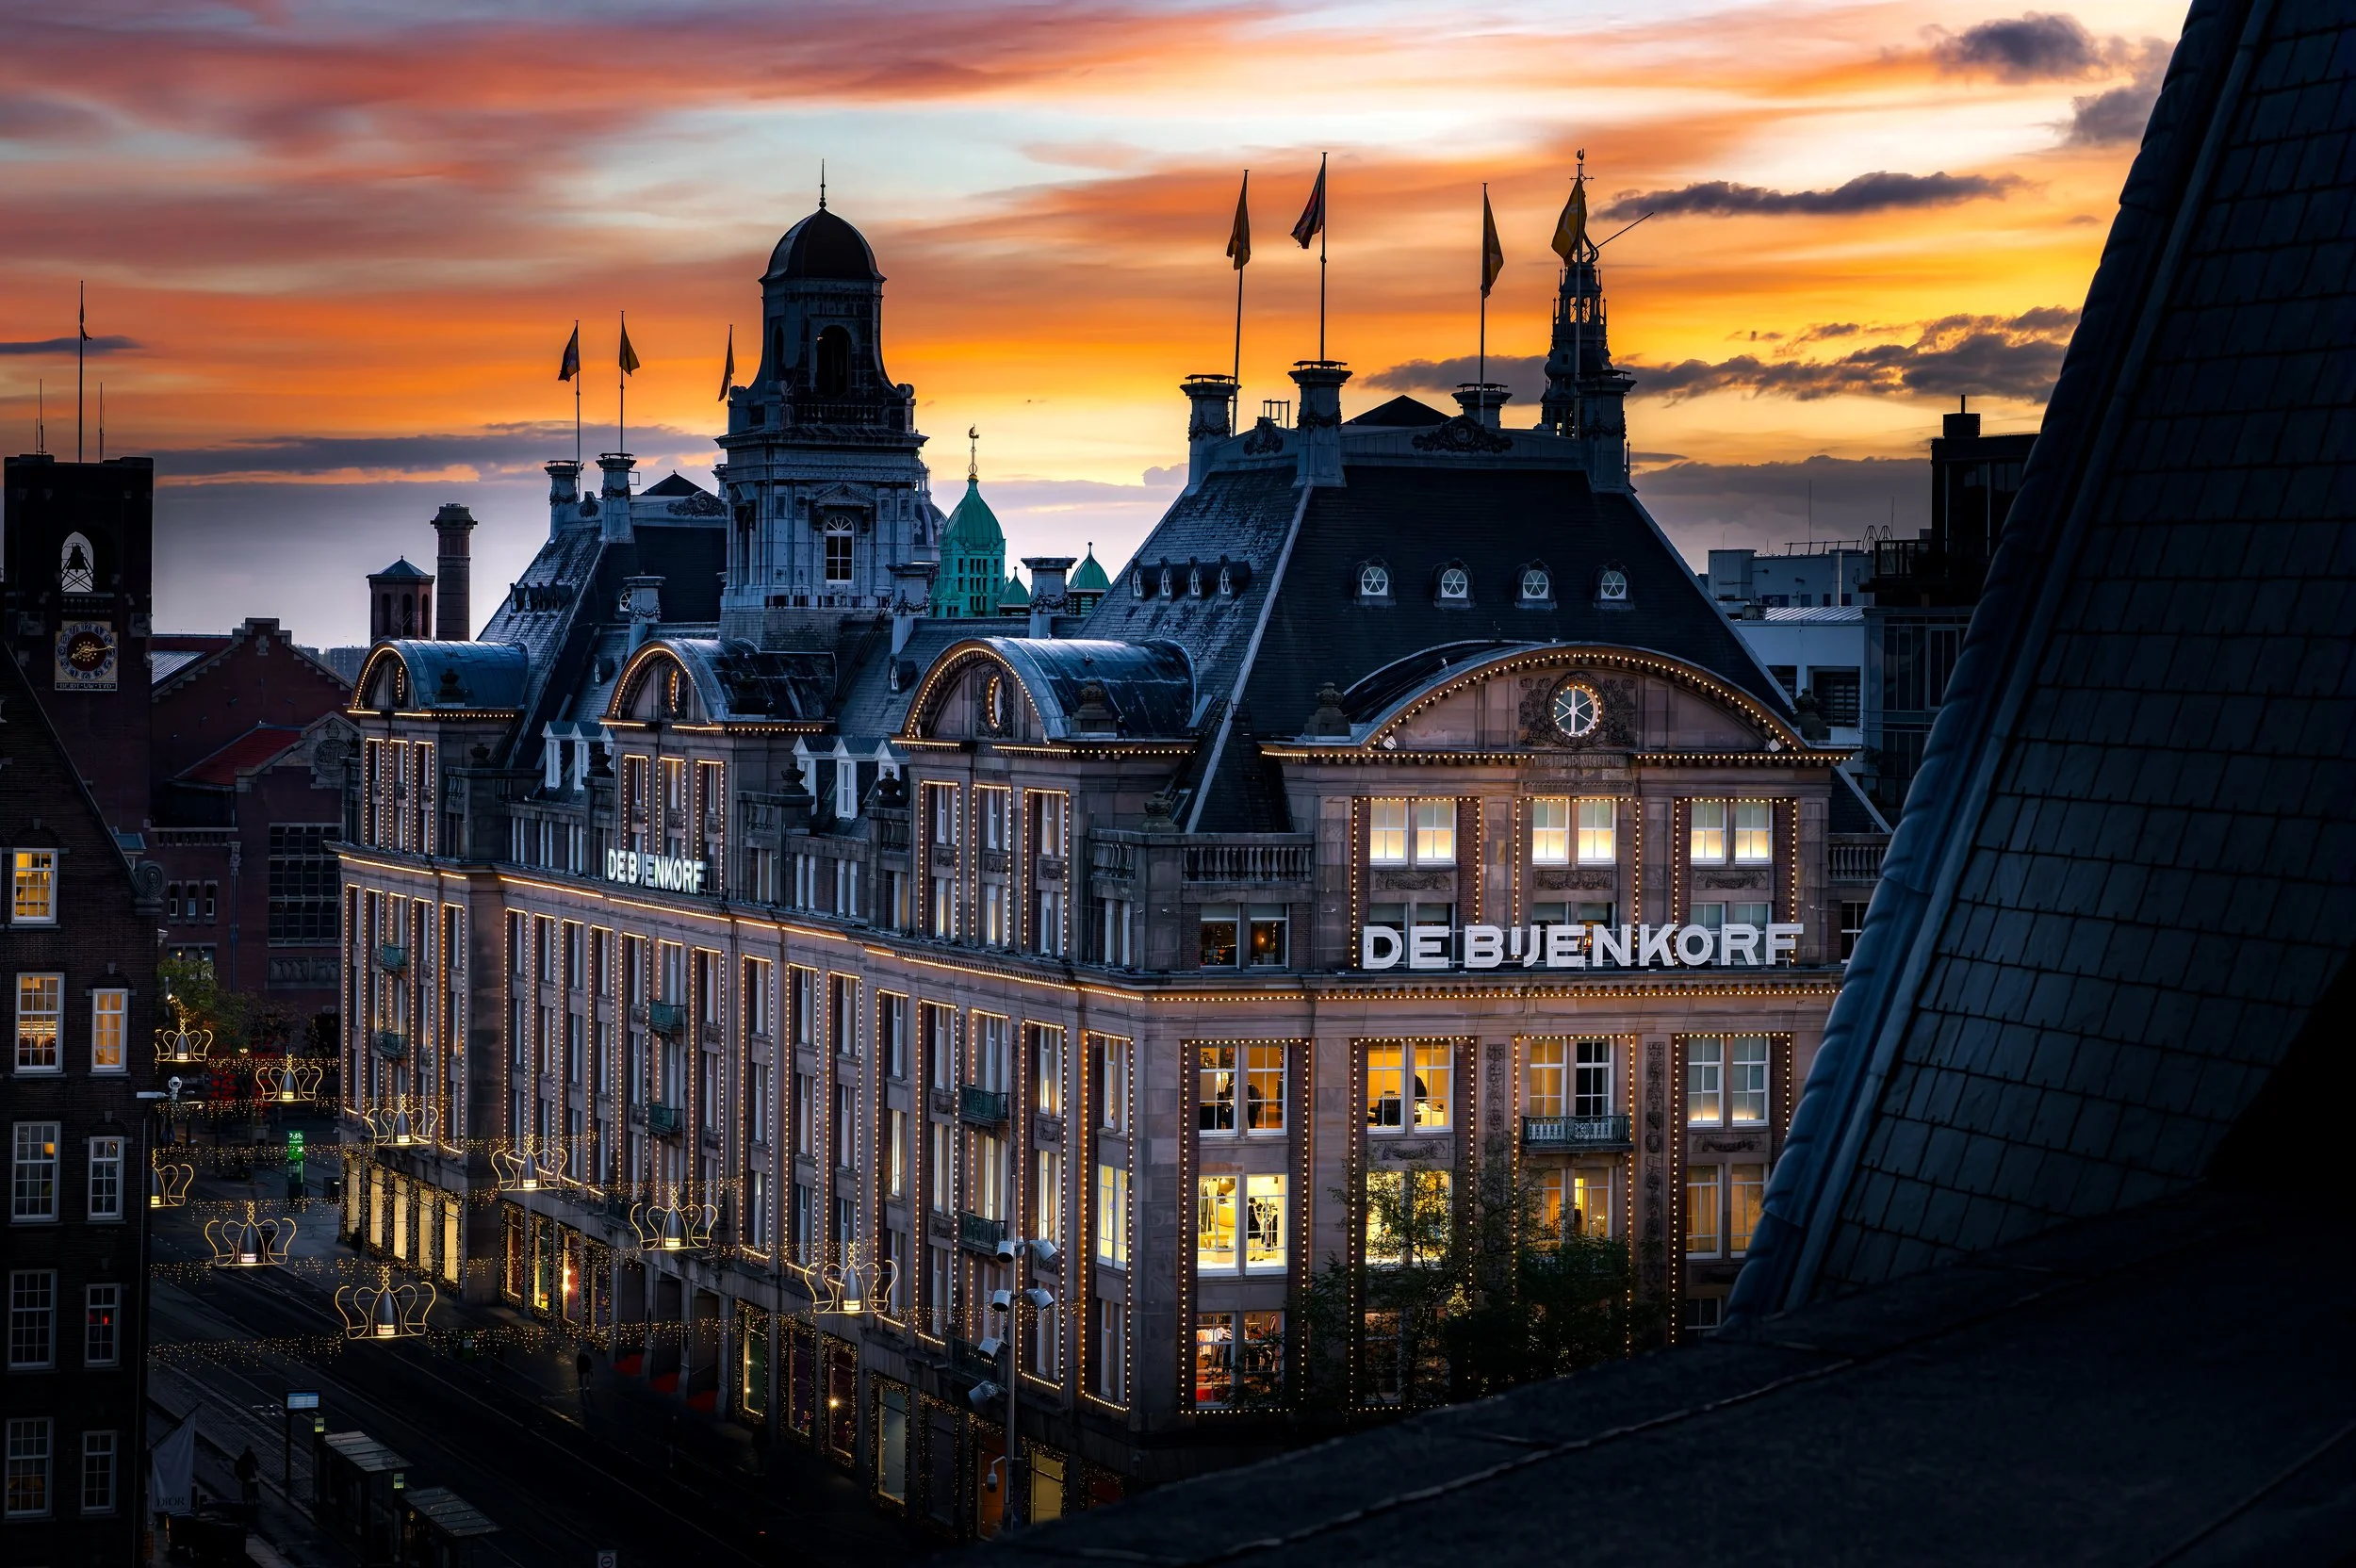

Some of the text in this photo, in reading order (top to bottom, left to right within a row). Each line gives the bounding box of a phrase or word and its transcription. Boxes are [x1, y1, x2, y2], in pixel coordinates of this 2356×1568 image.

[608, 848, 706, 893] DE BIJENKORF
[1363, 923, 1803, 969] DE BIJENKORF
[156, 1496, 185, 1507] DIOR
